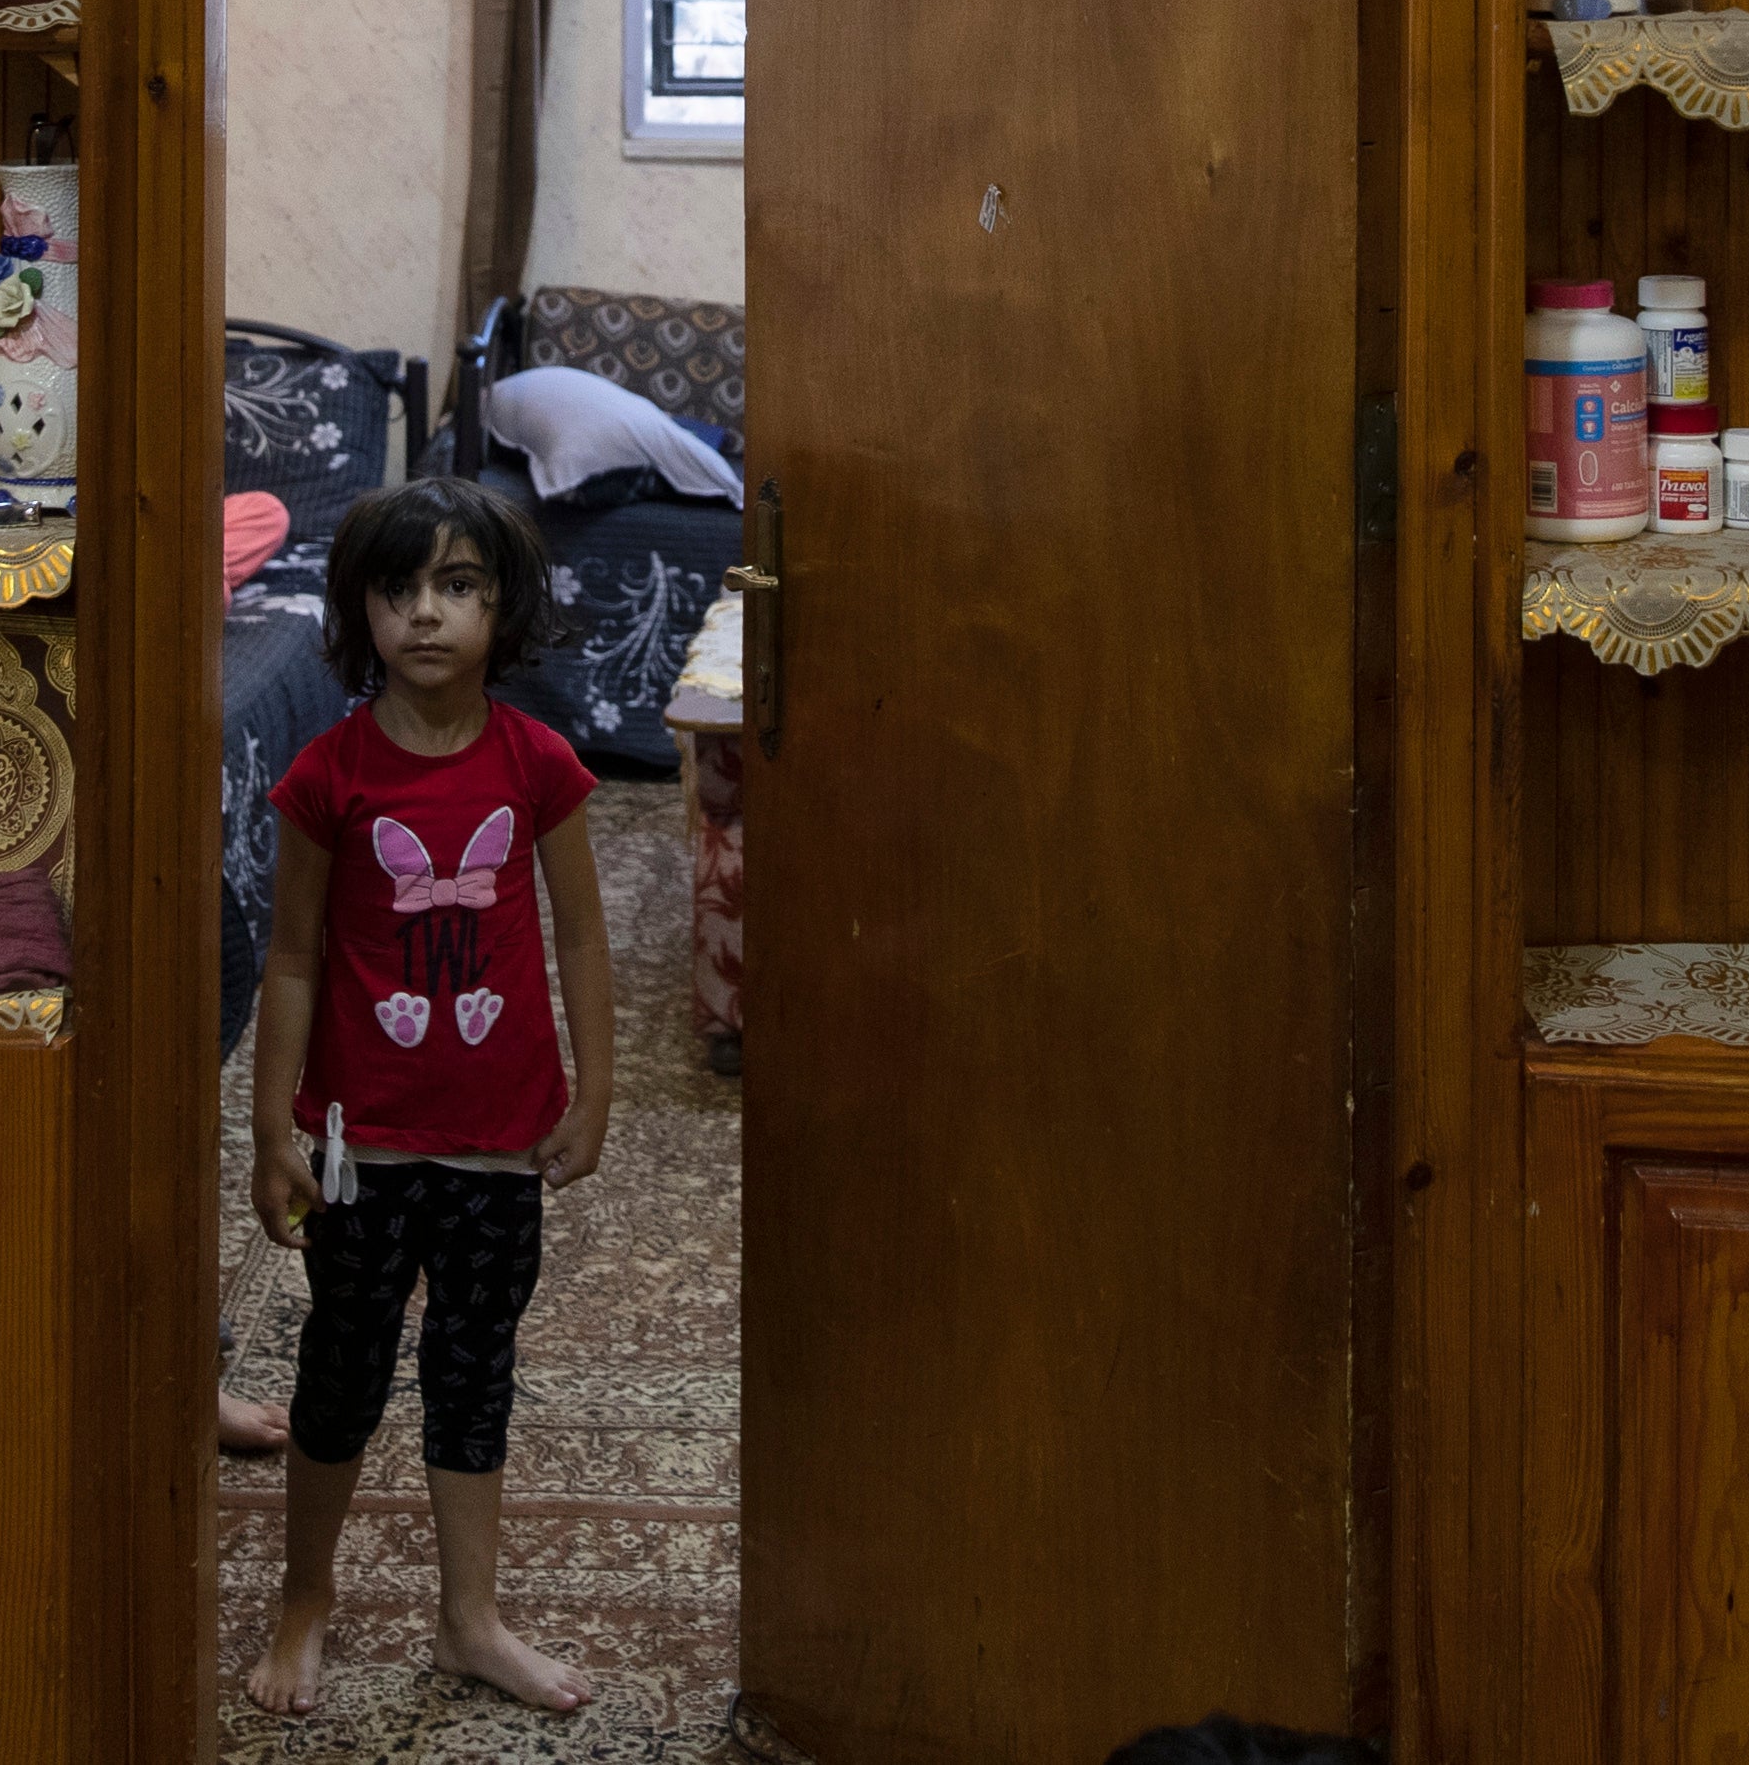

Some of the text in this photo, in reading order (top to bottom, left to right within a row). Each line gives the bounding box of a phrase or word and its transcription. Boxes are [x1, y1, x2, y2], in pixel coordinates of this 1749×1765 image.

[1660, 479, 1708, 493] TYLENOL
[1661, 494, 1708, 504] Extra Strength
